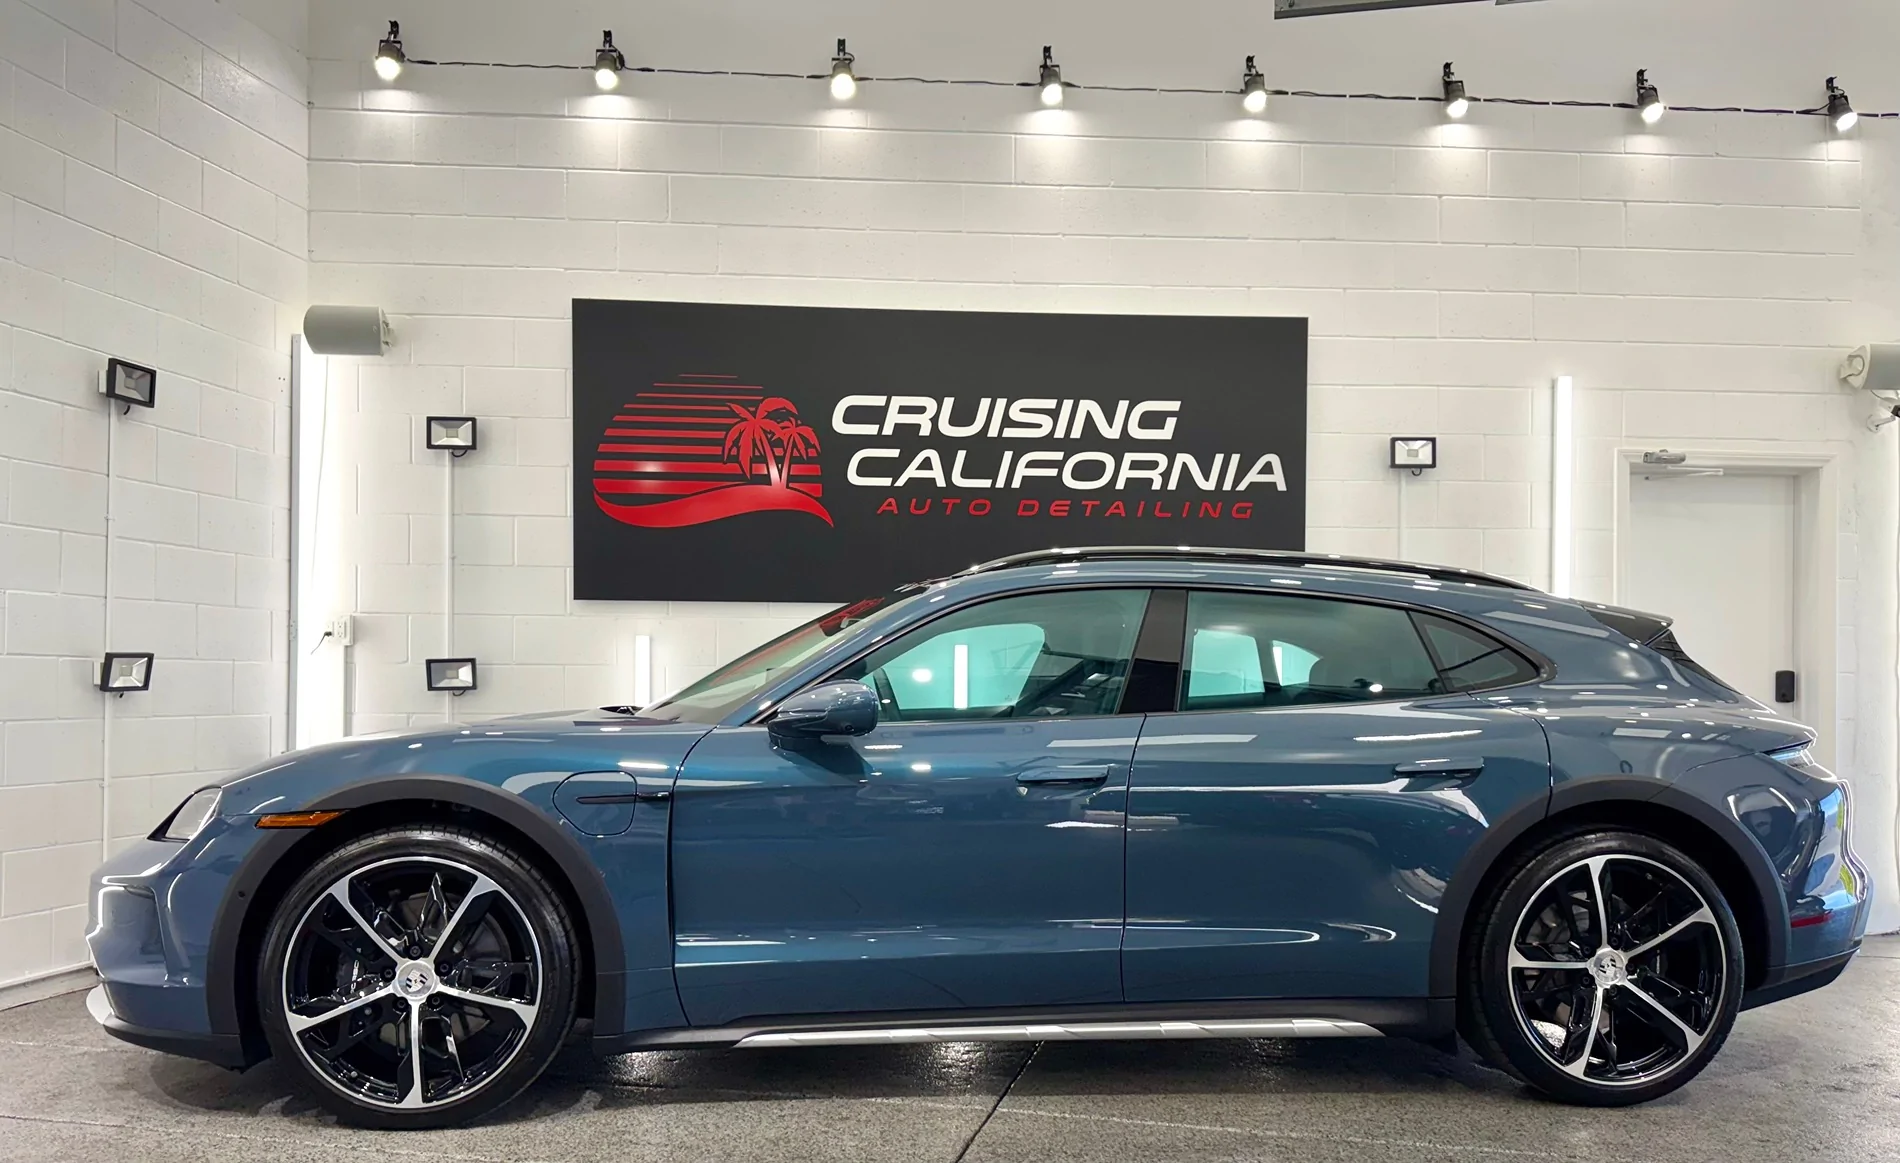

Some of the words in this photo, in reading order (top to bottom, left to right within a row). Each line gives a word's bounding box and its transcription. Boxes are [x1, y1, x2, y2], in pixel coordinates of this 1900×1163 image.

[831, 394, 1182, 440] CRUISING
[846, 448, 1288, 492] CALIFORNIA
[876, 497, 992, 517] AUTO
[1016, 498, 1254, 520] DETAILING
